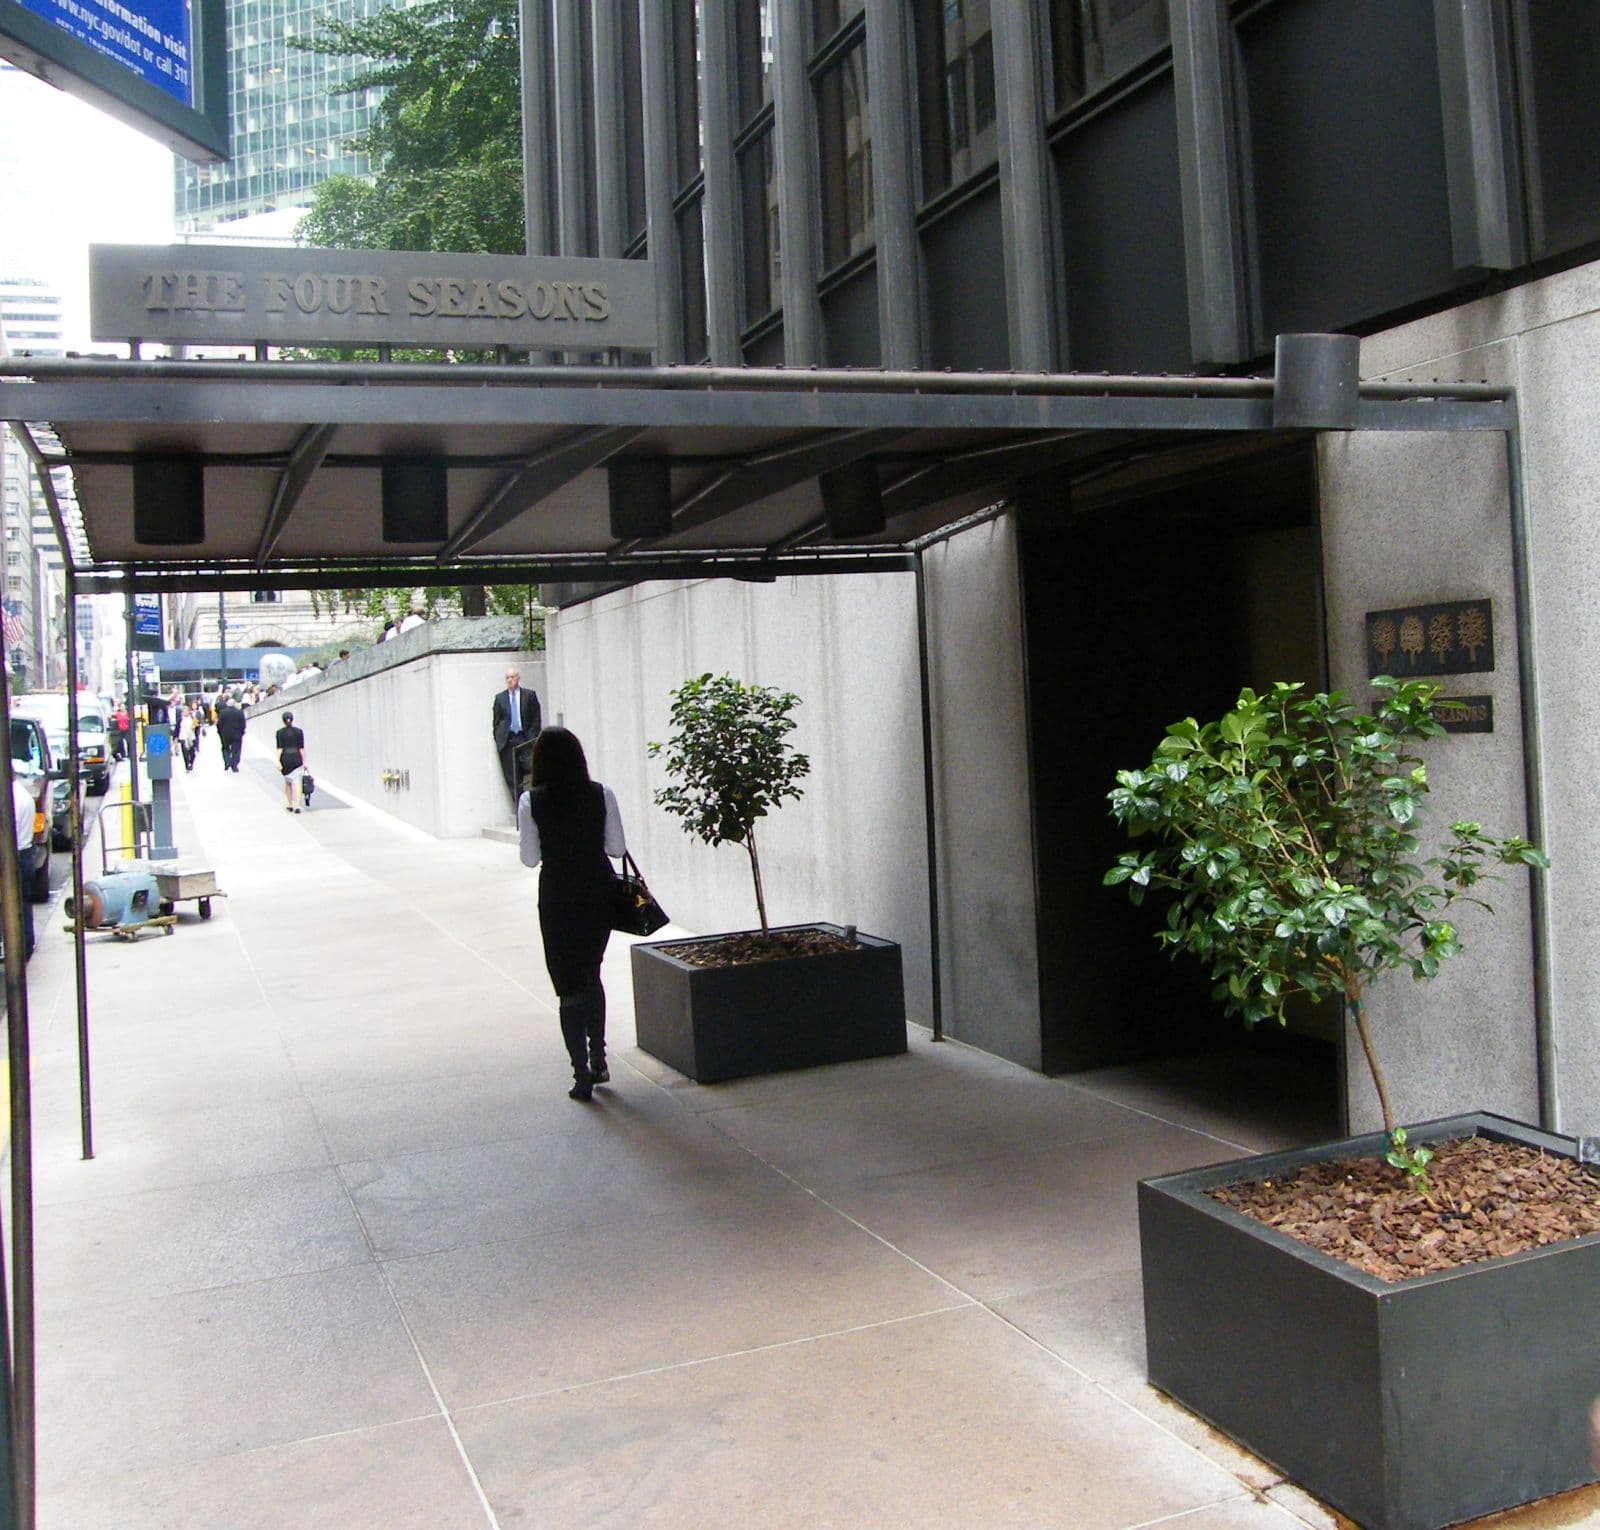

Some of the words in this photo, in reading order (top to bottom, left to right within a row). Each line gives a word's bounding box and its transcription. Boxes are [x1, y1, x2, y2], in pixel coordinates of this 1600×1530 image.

[51, 0, 142, 57] ww.nyc.gov/dot
[143, 47, 154, 63] or
[156, 55, 172, 76] call
[174, 63, 188, 86] 311
[95, 0, 161, 44] formation
[163, 34, 187, 61] visit
[143, 270, 246, 314] THE
[264, 272, 391, 318] FOUR
[408, 276, 610, 323] SEASONS
